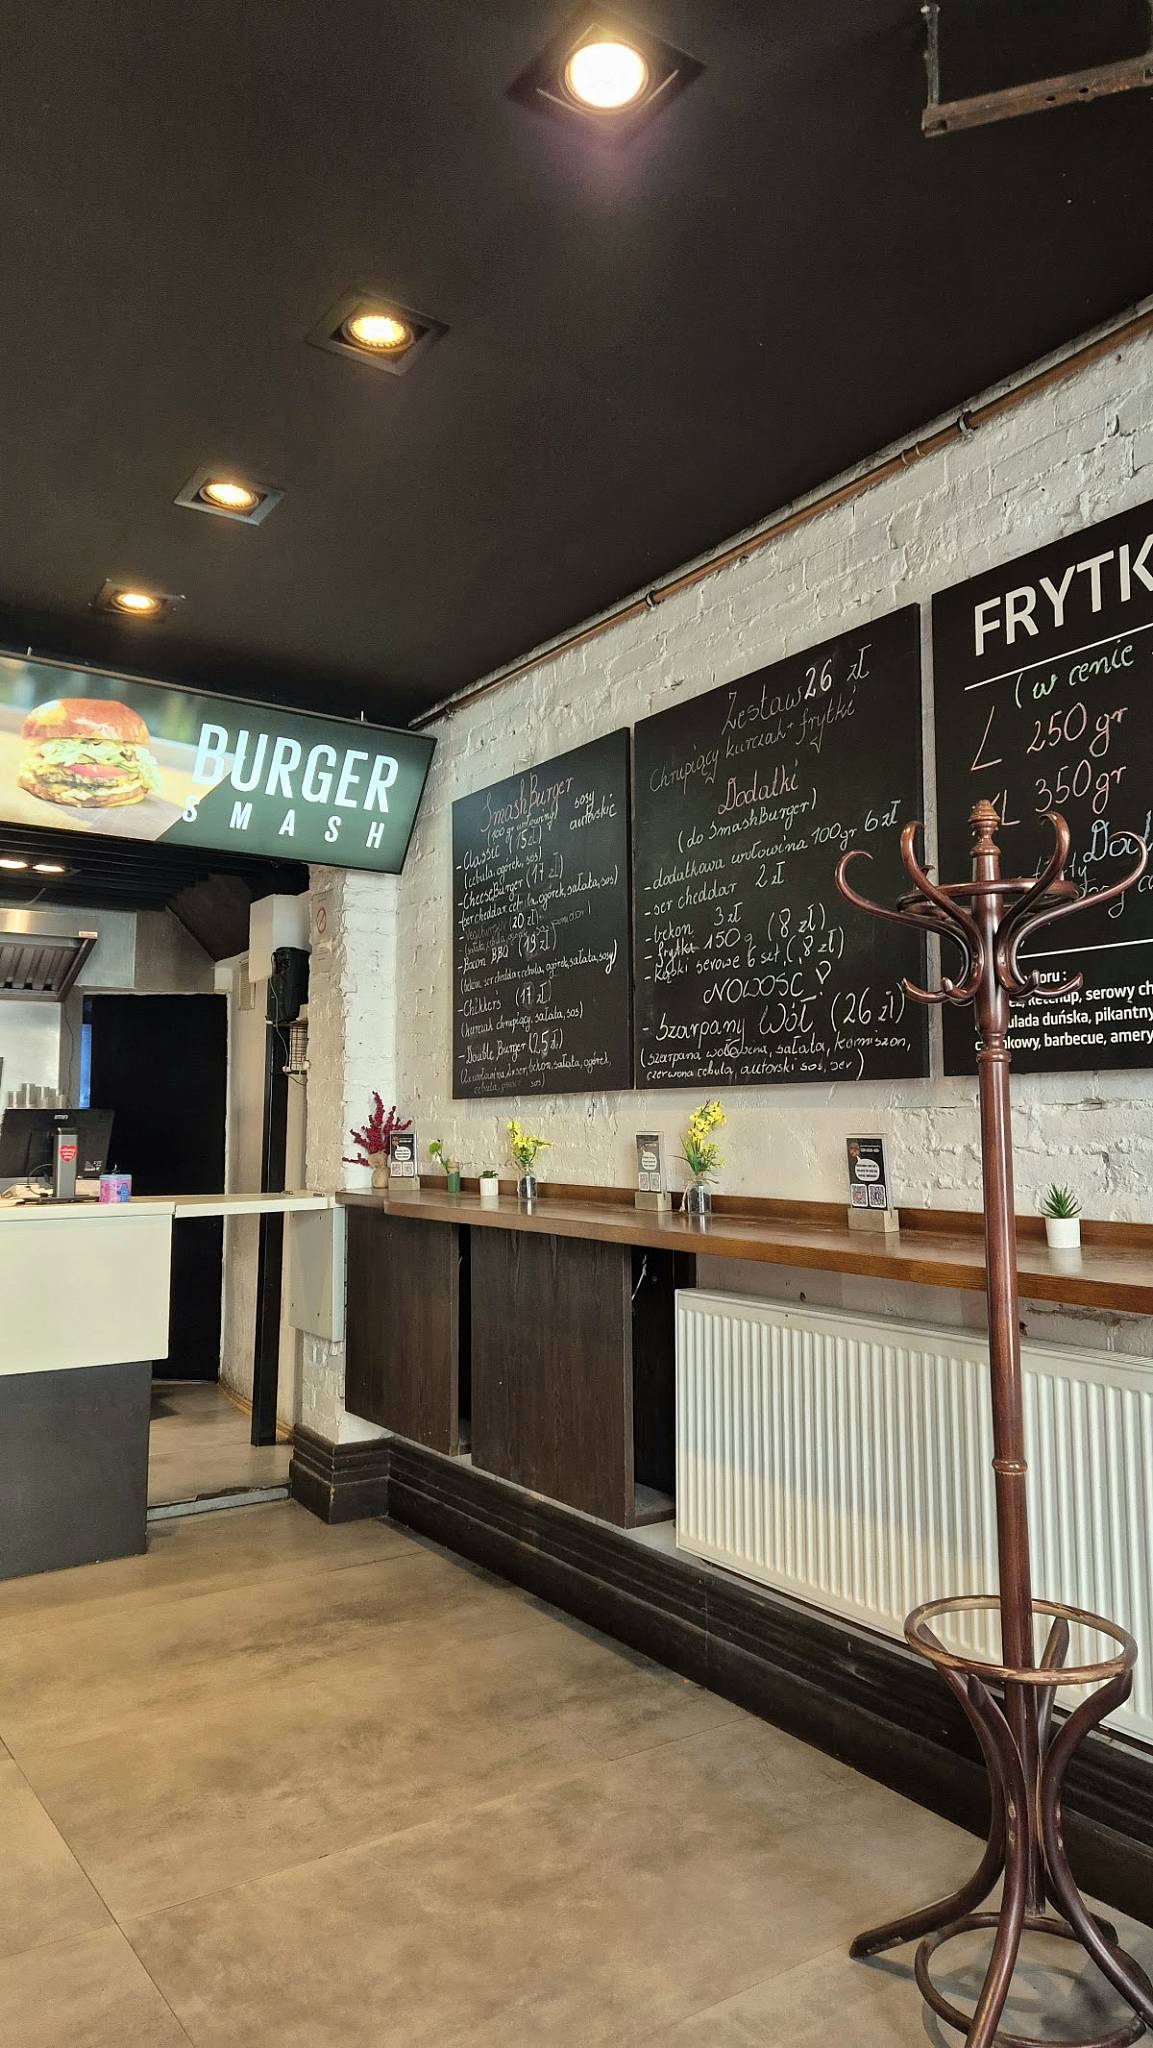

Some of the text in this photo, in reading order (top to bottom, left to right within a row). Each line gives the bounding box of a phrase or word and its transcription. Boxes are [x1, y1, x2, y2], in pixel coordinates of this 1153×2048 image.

[1068, 640, 1135, 686] cenie
[721, 644, 872, 735] Zestaw 26 zł
[725, 716, 786, 759] kurczak
[795, 685, 857, 753] frytki
[970, 705, 1003, 771] L
[192, 722, 399, 813] BURGER
[718, 759, 799, 815] Dodatki
[183, 797, 385, 850] SMASH
[678, 879, 738, 910] cheddar
[696, 952, 740, 975] serowe
[759, 995, 817, 1035] Wół
[1086, 985, 1135, 1002] serowy
[1042, 1009, 1092, 1026] duńska,
[1044, 1031, 1107, 1047] barbecue,
[740, 1056, 797, 1077] autorski
